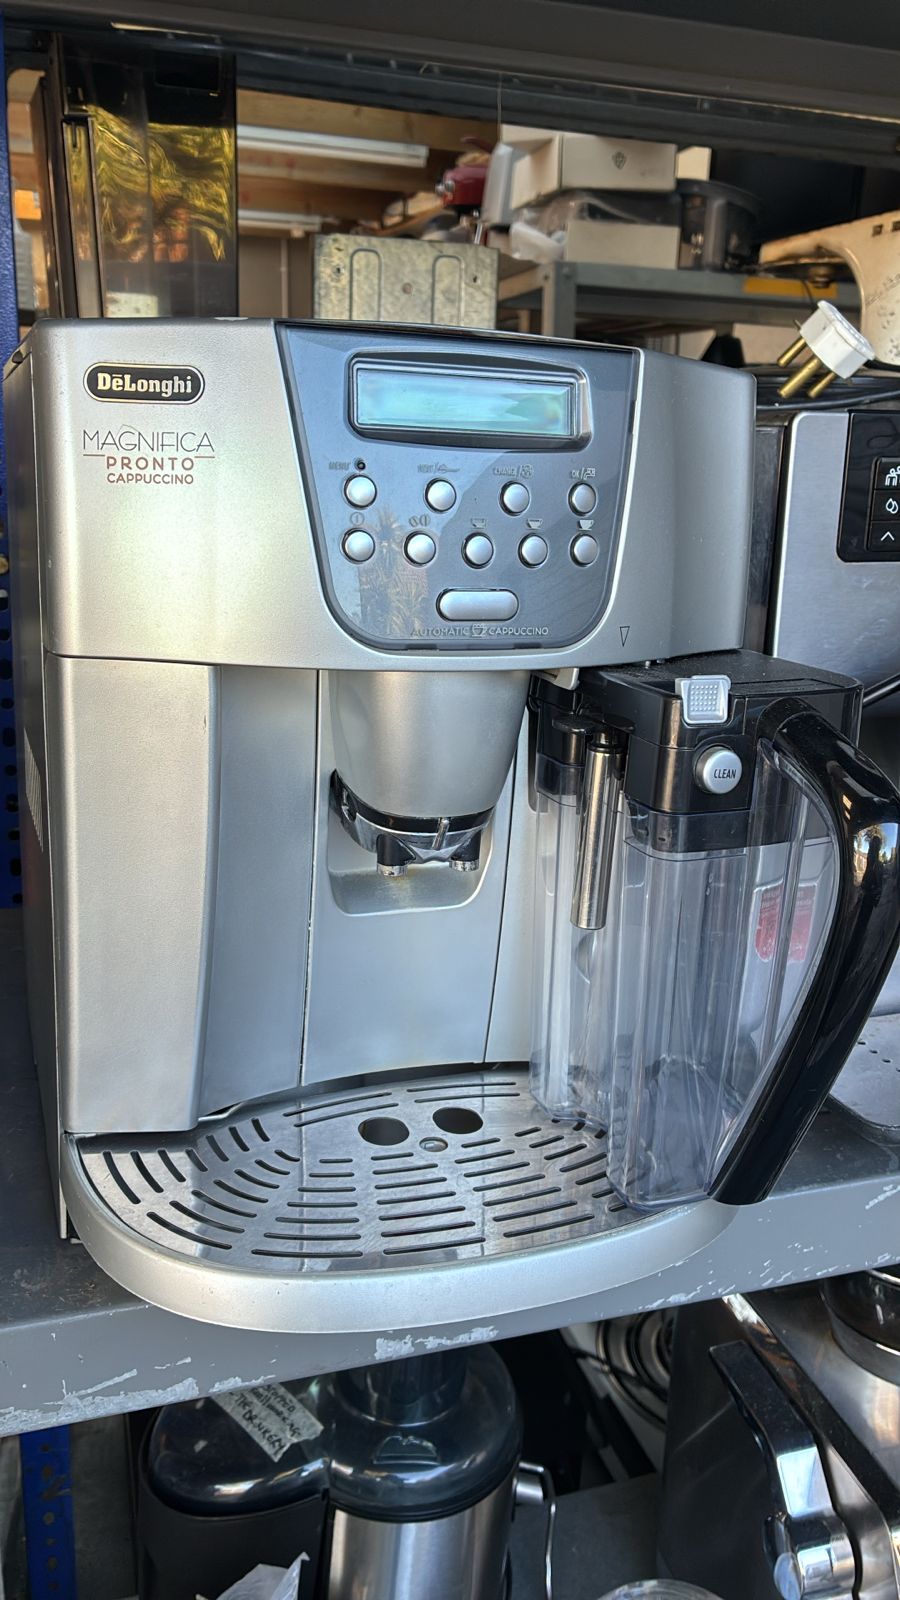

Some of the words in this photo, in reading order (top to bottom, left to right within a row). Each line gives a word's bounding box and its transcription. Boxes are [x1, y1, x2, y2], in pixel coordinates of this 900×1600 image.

[83, 429, 215, 453] MAGNIFICA
[106, 456, 194, 471] PRONTO
[107, 473, 194, 485] CAPPUCCINO
[411, 627, 471, 637] AUTOMATIC
[488, 626, 549, 637] CAPPUCCINO
[713, 768, 737, 779] CLEAN
